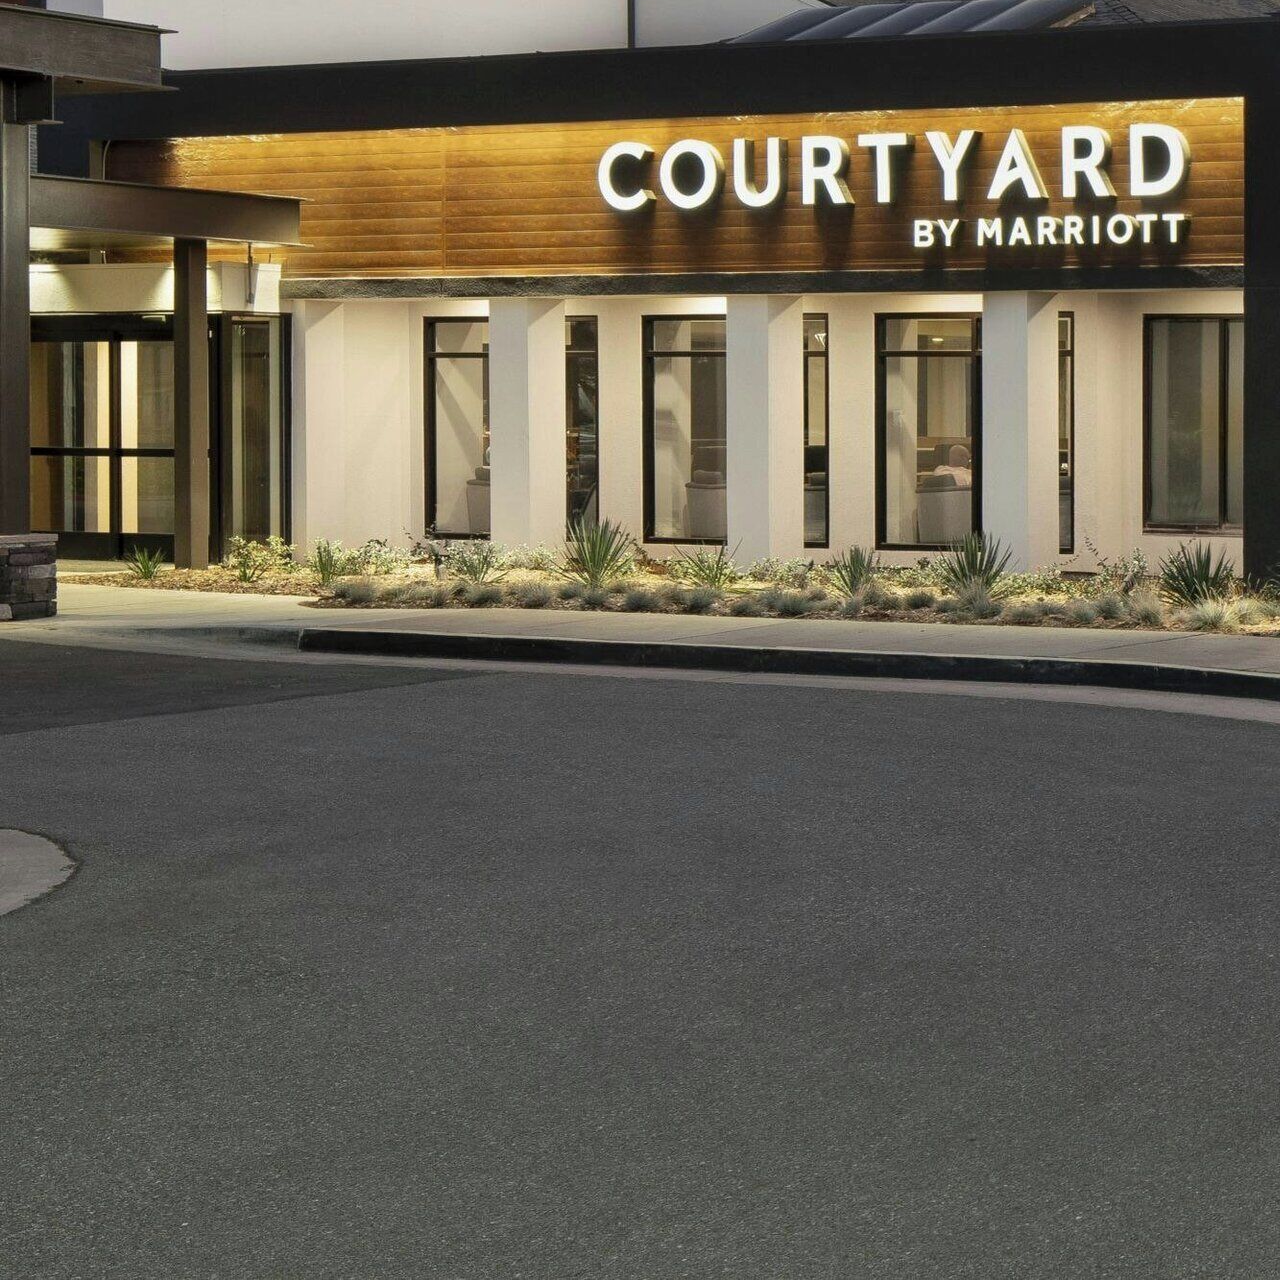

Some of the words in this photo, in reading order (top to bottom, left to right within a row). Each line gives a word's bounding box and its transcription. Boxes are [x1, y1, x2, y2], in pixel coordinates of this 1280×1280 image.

[598, 123, 1192, 211] COURTYARD
[913, 218, 960, 248] BY
[976, 213, 1187, 247] MARRIOTT
